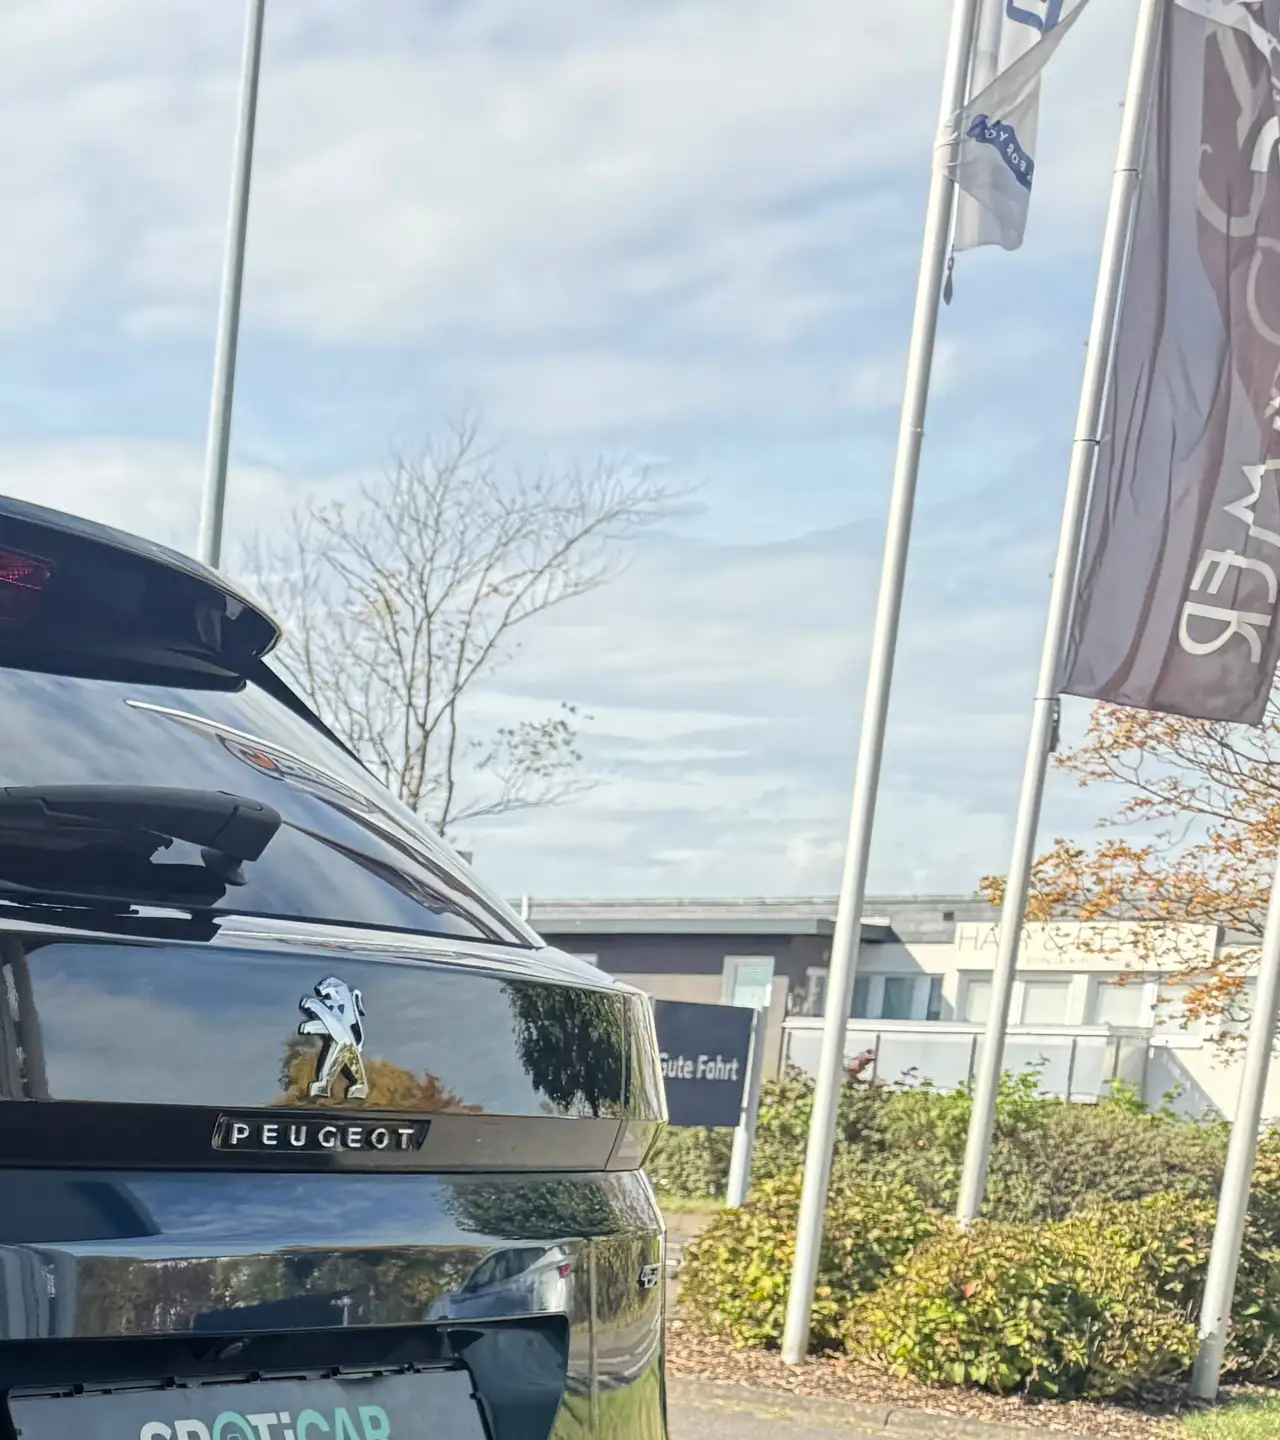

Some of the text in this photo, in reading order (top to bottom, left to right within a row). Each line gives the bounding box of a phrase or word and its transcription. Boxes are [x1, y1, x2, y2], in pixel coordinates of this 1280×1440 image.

[659, 1052, 740, 1081] Gute Fahrt
[230, 1123, 415, 1149] PEUGEOT
